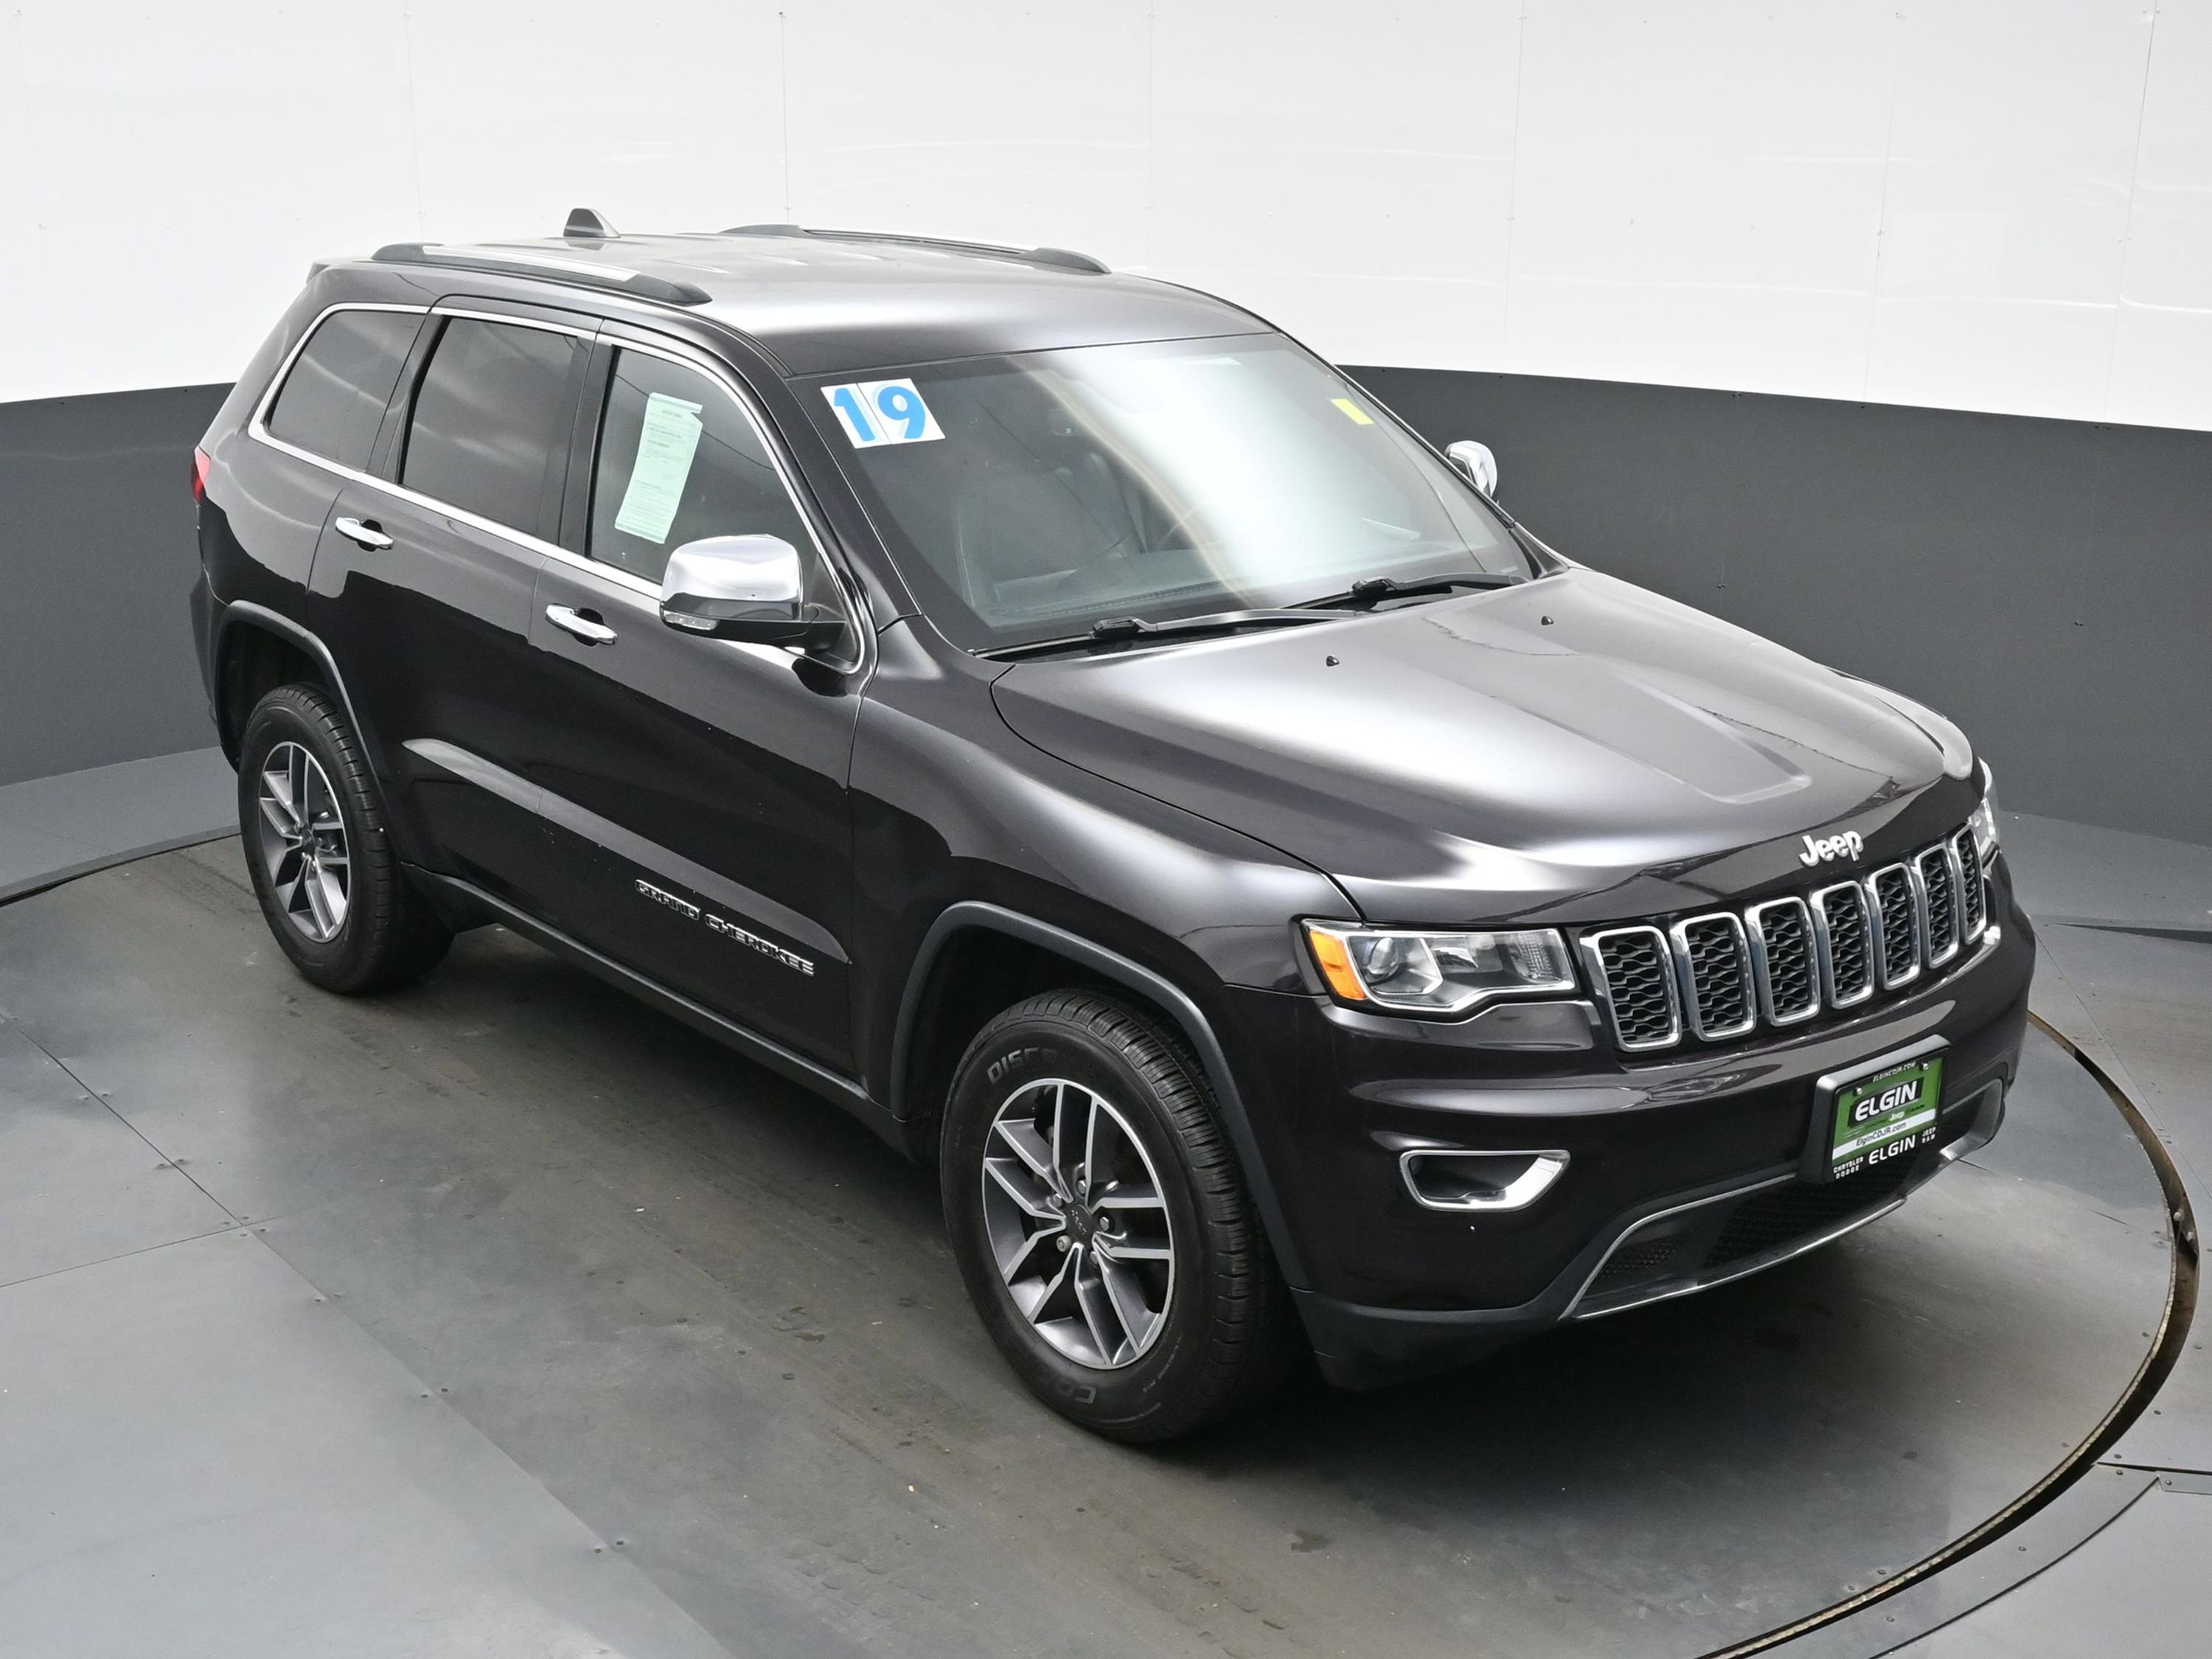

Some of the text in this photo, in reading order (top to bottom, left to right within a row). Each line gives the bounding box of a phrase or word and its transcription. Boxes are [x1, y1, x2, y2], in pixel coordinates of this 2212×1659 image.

[834, 386, 926, 442] 19
[1799, 831, 1863, 866] Jeep
[635, 879, 814, 977] GRAND CHEROKEE
[1873, 1062, 1916, 1082] ELGINCDJR.COM
[1855, 1082, 1916, 1121] ELGIN
[1855, 1122, 1907, 1147] ElginCDJR.com
[1921, 1127, 1936, 1137] JEEP
[1869, 1135, 1916, 1164] ELGIN
[1834, 1157, 1863, 1173] CHRYSLER
[1835, 1165, 1860, 1180] DODGE
